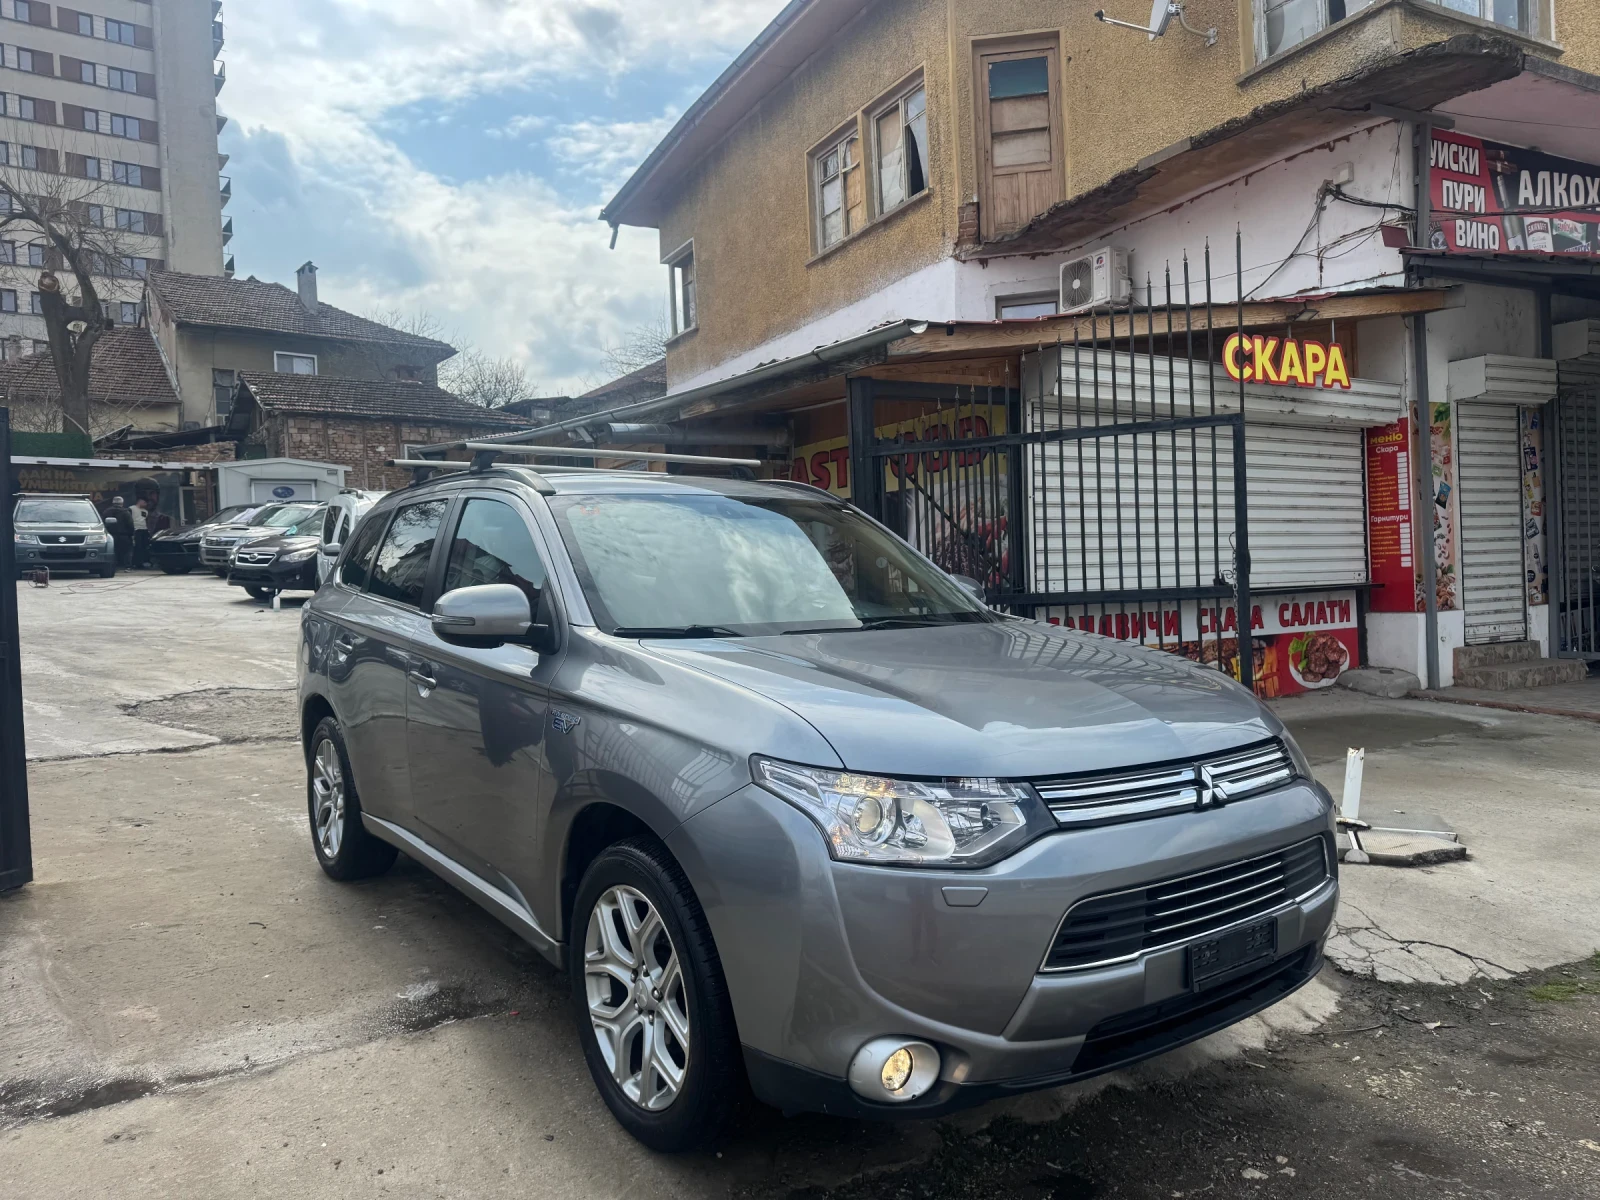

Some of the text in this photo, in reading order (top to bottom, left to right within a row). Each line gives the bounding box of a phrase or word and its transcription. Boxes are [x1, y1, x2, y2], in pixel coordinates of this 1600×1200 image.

[1442, 179, 1485, 213] ПУРИ
[1455, 219, 1499, 250] ВИНО
[1223, 333, 1351, 389] СКАРА
[1370, 433, 1403, 444] меню
[1376, 445, 1399, 454] Скара
[54, 469, 76, 480] НА
[19, 479, 98, 491] УМЕНИЯТА
[1371, 515, 1408, 524] Гарнитури
[1198, 605, 1264, 634] СКАА
[1278, 599, 1351, 628] САЛАТИ
